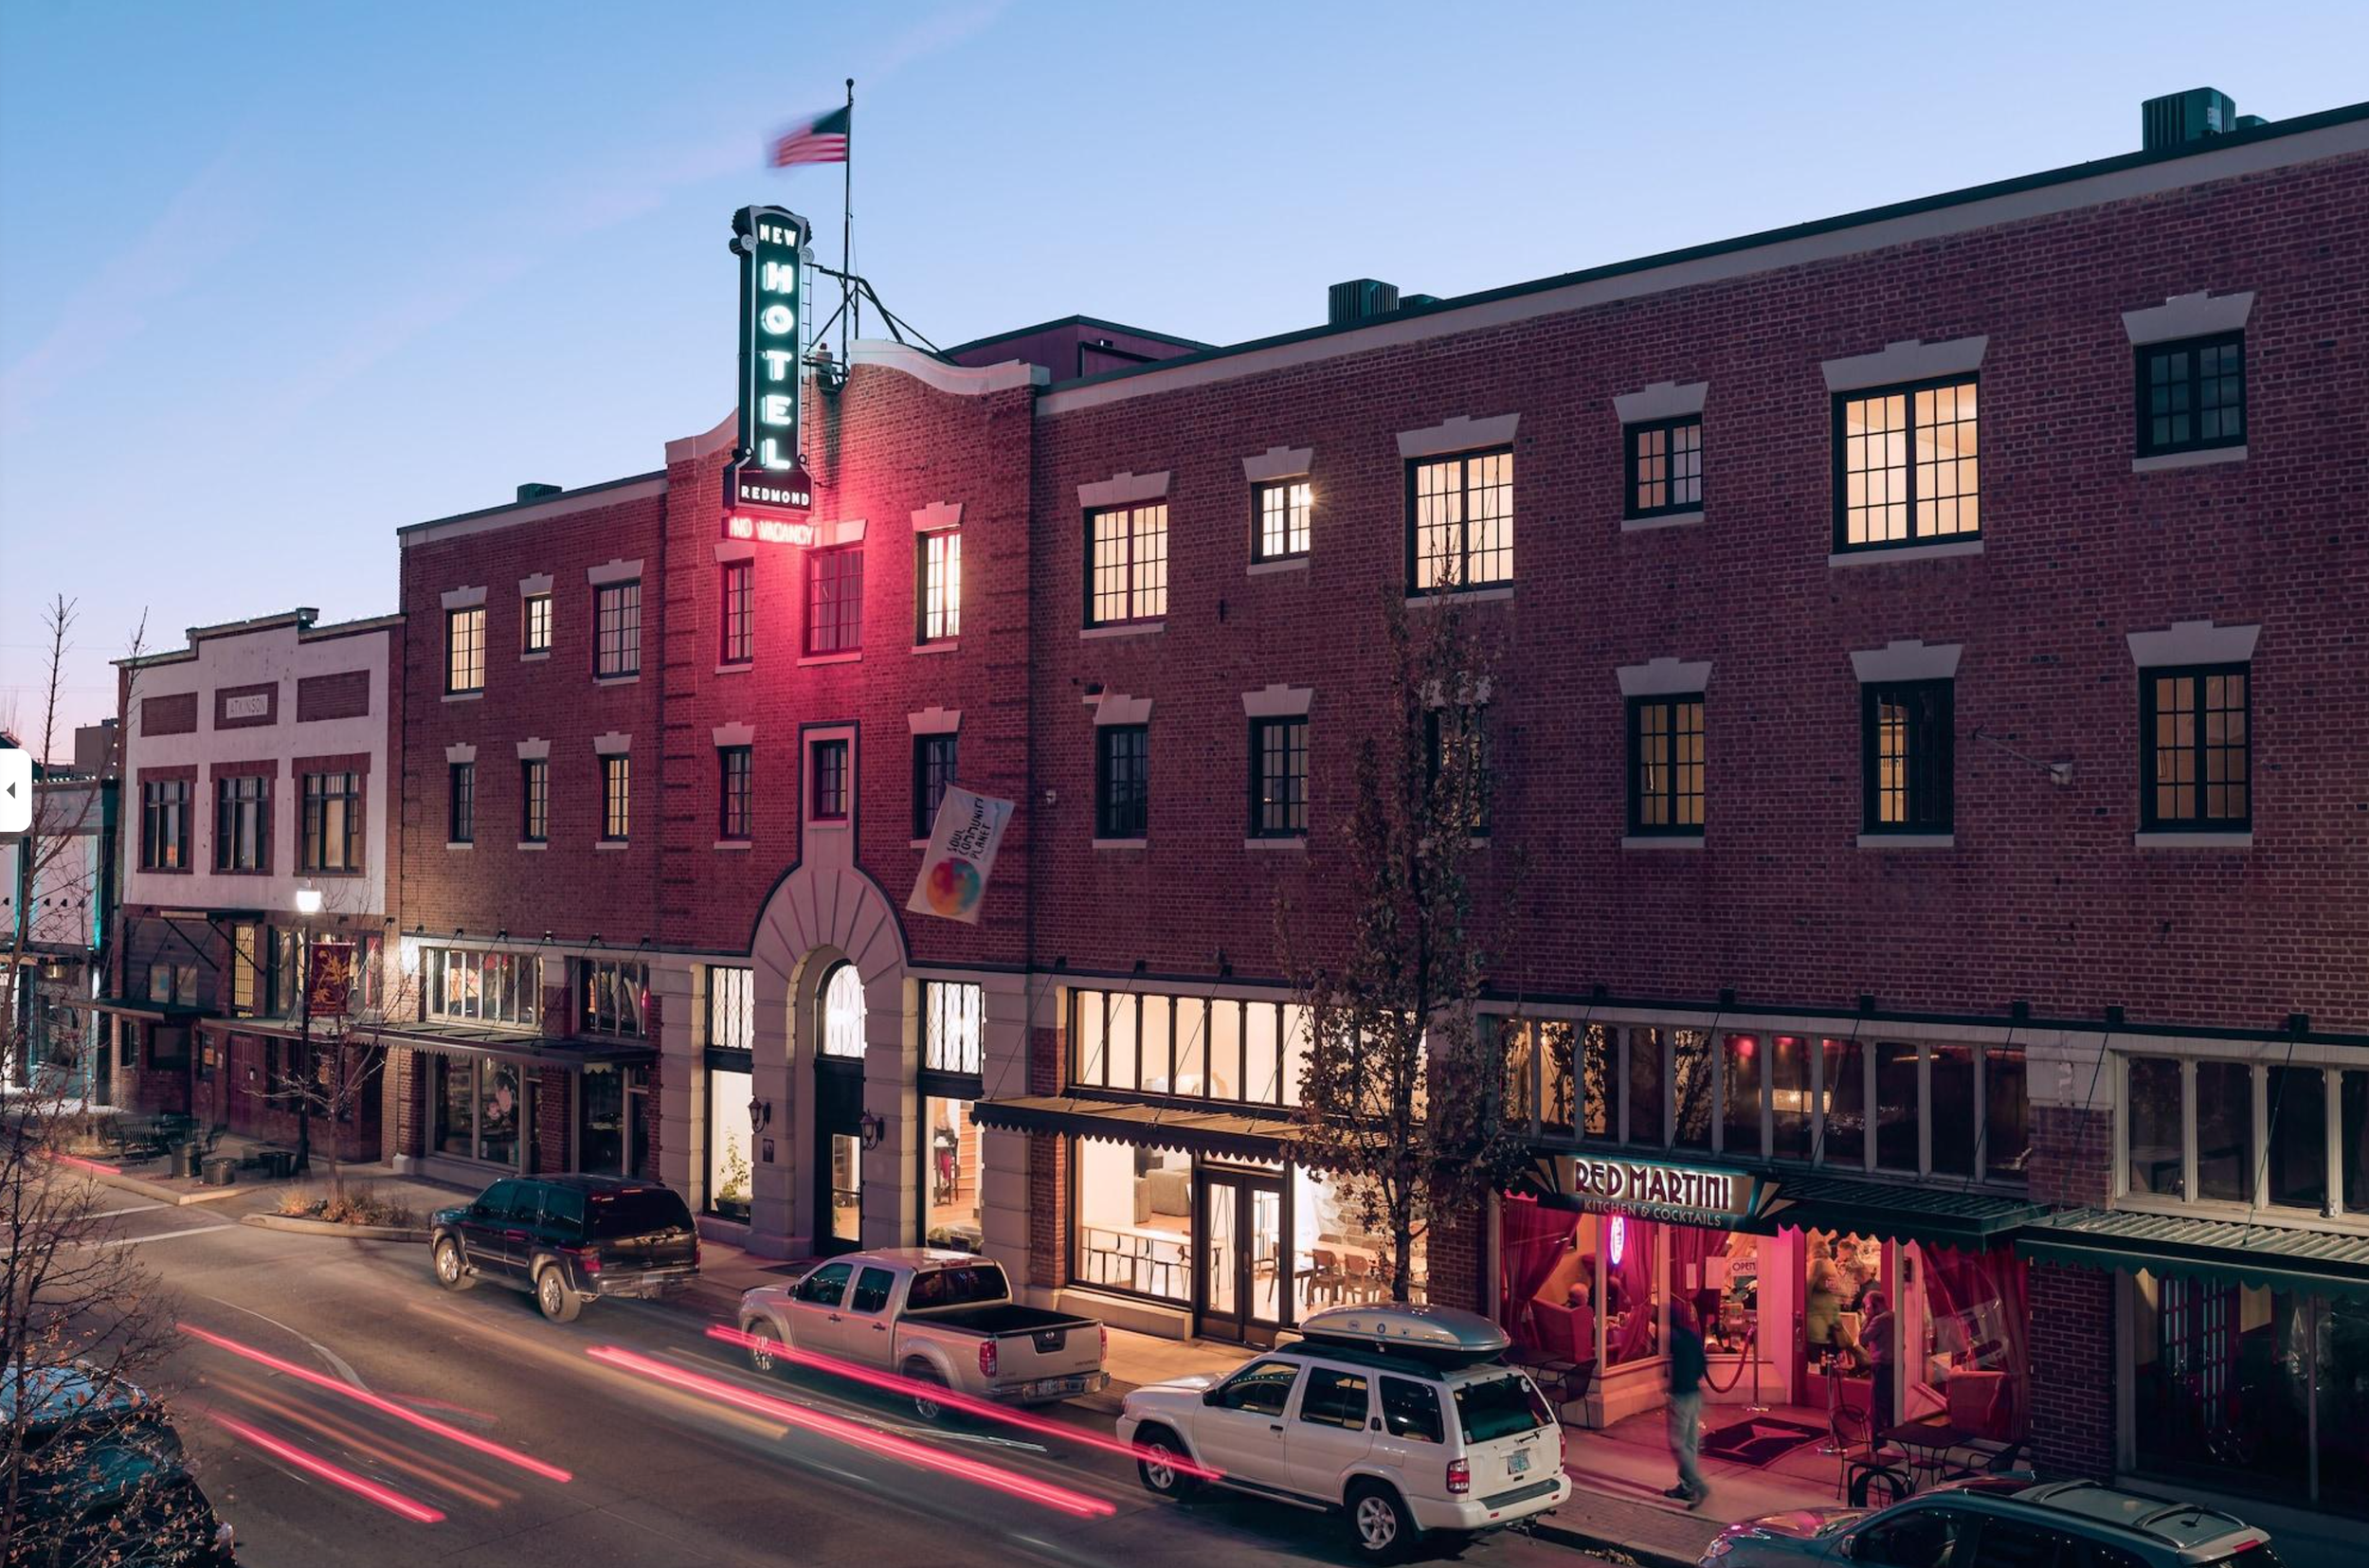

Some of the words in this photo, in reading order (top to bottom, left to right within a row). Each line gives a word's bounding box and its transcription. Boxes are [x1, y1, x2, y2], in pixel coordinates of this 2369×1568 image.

[759, 224, 797, 247] NEW
[761, 261, 794, 470] HOTEL
[741, 486, 810, 506] REDMOND
[729, 517, 751, 538] NO
[756, 520, 815, 546] VACANCY
[228, 696, 266, 715] ATKINSON
[959, 798, 984, 856] COMMUNITY
[947, 830, 966, 853] SOUL
[970, 824, 991, 860] PLANET
[1575, 1161, 1622, 1196] RED
[1629, 1165, 1729, 1210] MARTINI
[1583, 1199, 1637, 1217] KITCHEN
[1640, 1208, 1649, 1217] &
[1654, 1207, 1722, 1227] COCKTAILS
[1732, 1262, 1756, 1271] OPEN
